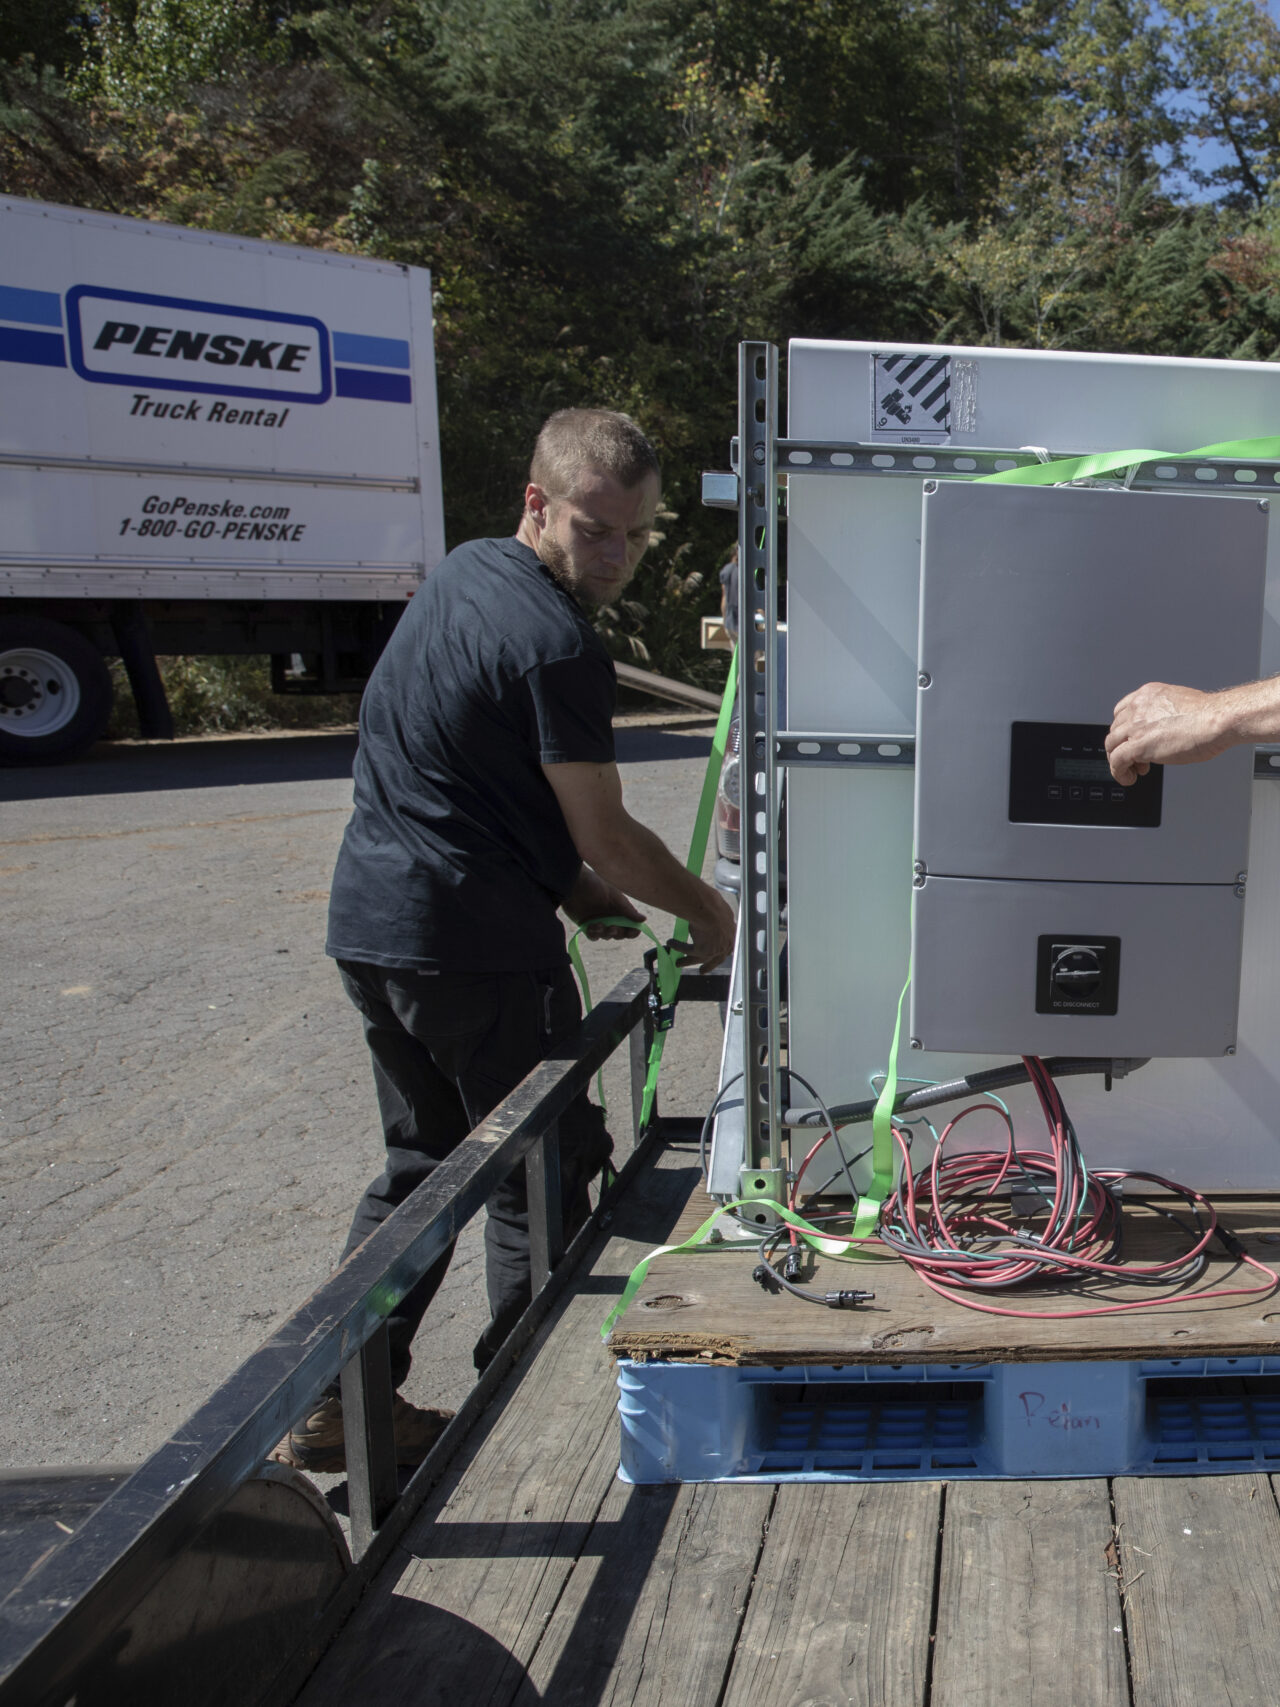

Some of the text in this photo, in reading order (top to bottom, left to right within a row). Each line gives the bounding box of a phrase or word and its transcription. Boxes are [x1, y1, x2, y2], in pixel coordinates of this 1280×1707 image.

[93, 320, 311, 373] PENSKE
[130, 394, 290, 429] Truck Rental
[142, 495, 291, 520] GoPenske.com
[119, 518, 306, 542] 1-800-GO-PENSKE
